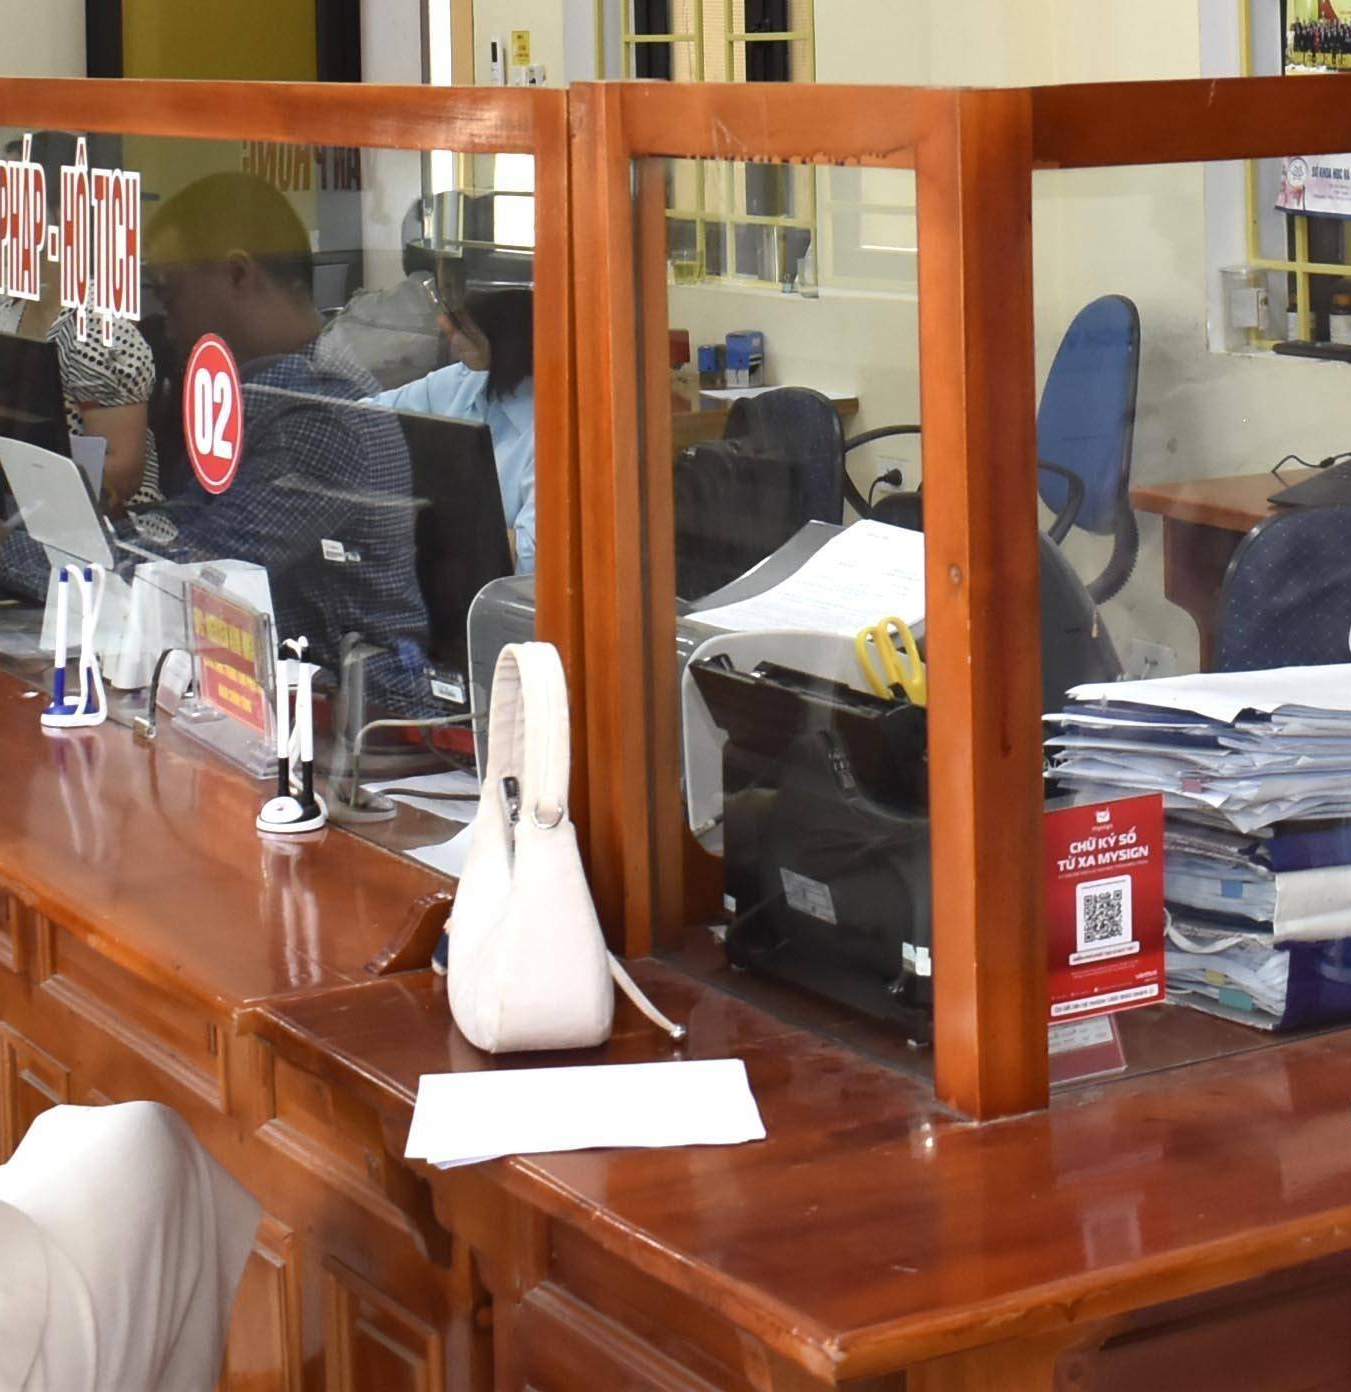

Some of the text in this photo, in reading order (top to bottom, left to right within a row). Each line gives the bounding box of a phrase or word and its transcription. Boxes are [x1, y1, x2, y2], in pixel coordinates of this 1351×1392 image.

[61, 137, 90, 342] HỘ
[91, 168, 141, 348] TỊCH
[195, 368, 233, 461] 02
[1070, 826, 1137, 854] CHỮ KÝ SỐ
[1078, 856, 1096, 868] XA
[1098, 845, 1149, 864] MYSIGN
